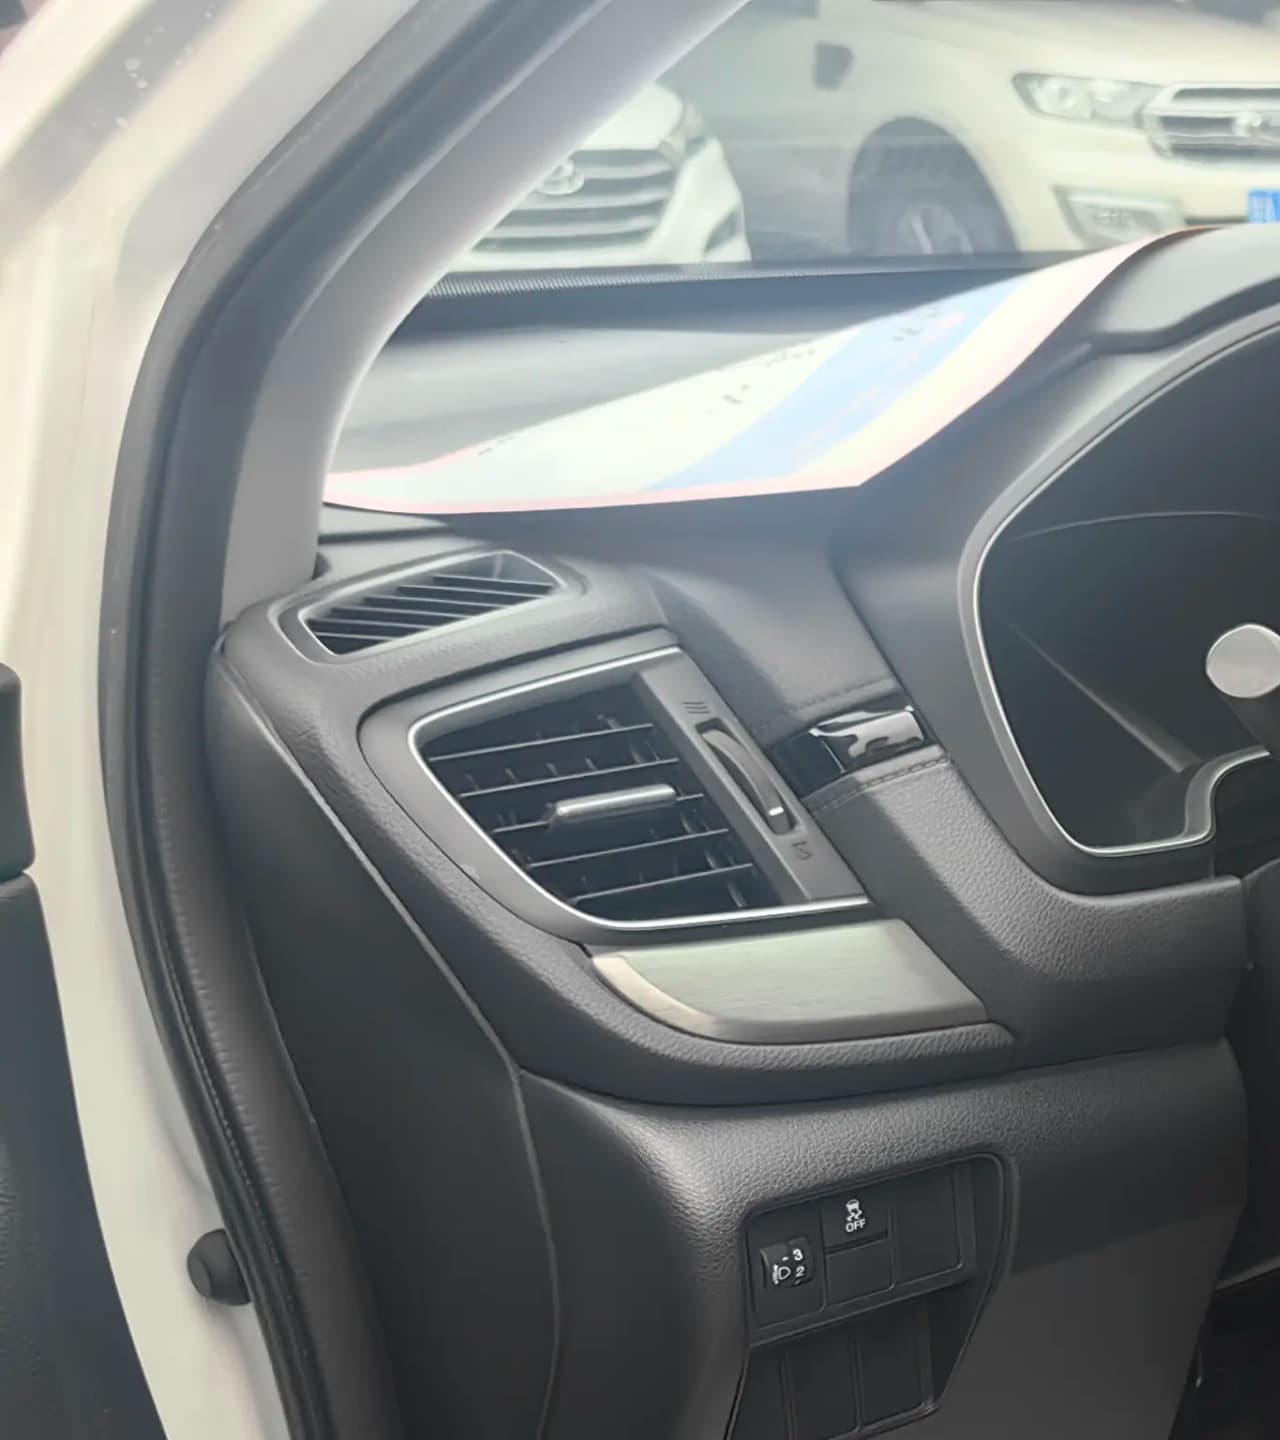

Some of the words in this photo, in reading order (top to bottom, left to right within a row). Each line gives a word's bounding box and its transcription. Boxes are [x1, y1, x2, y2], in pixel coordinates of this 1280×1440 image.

[845, 1218, 866, 1233] OFF
[792, 1248, 803, 1261] 3
[795, 1265, 805, 1278] 2
